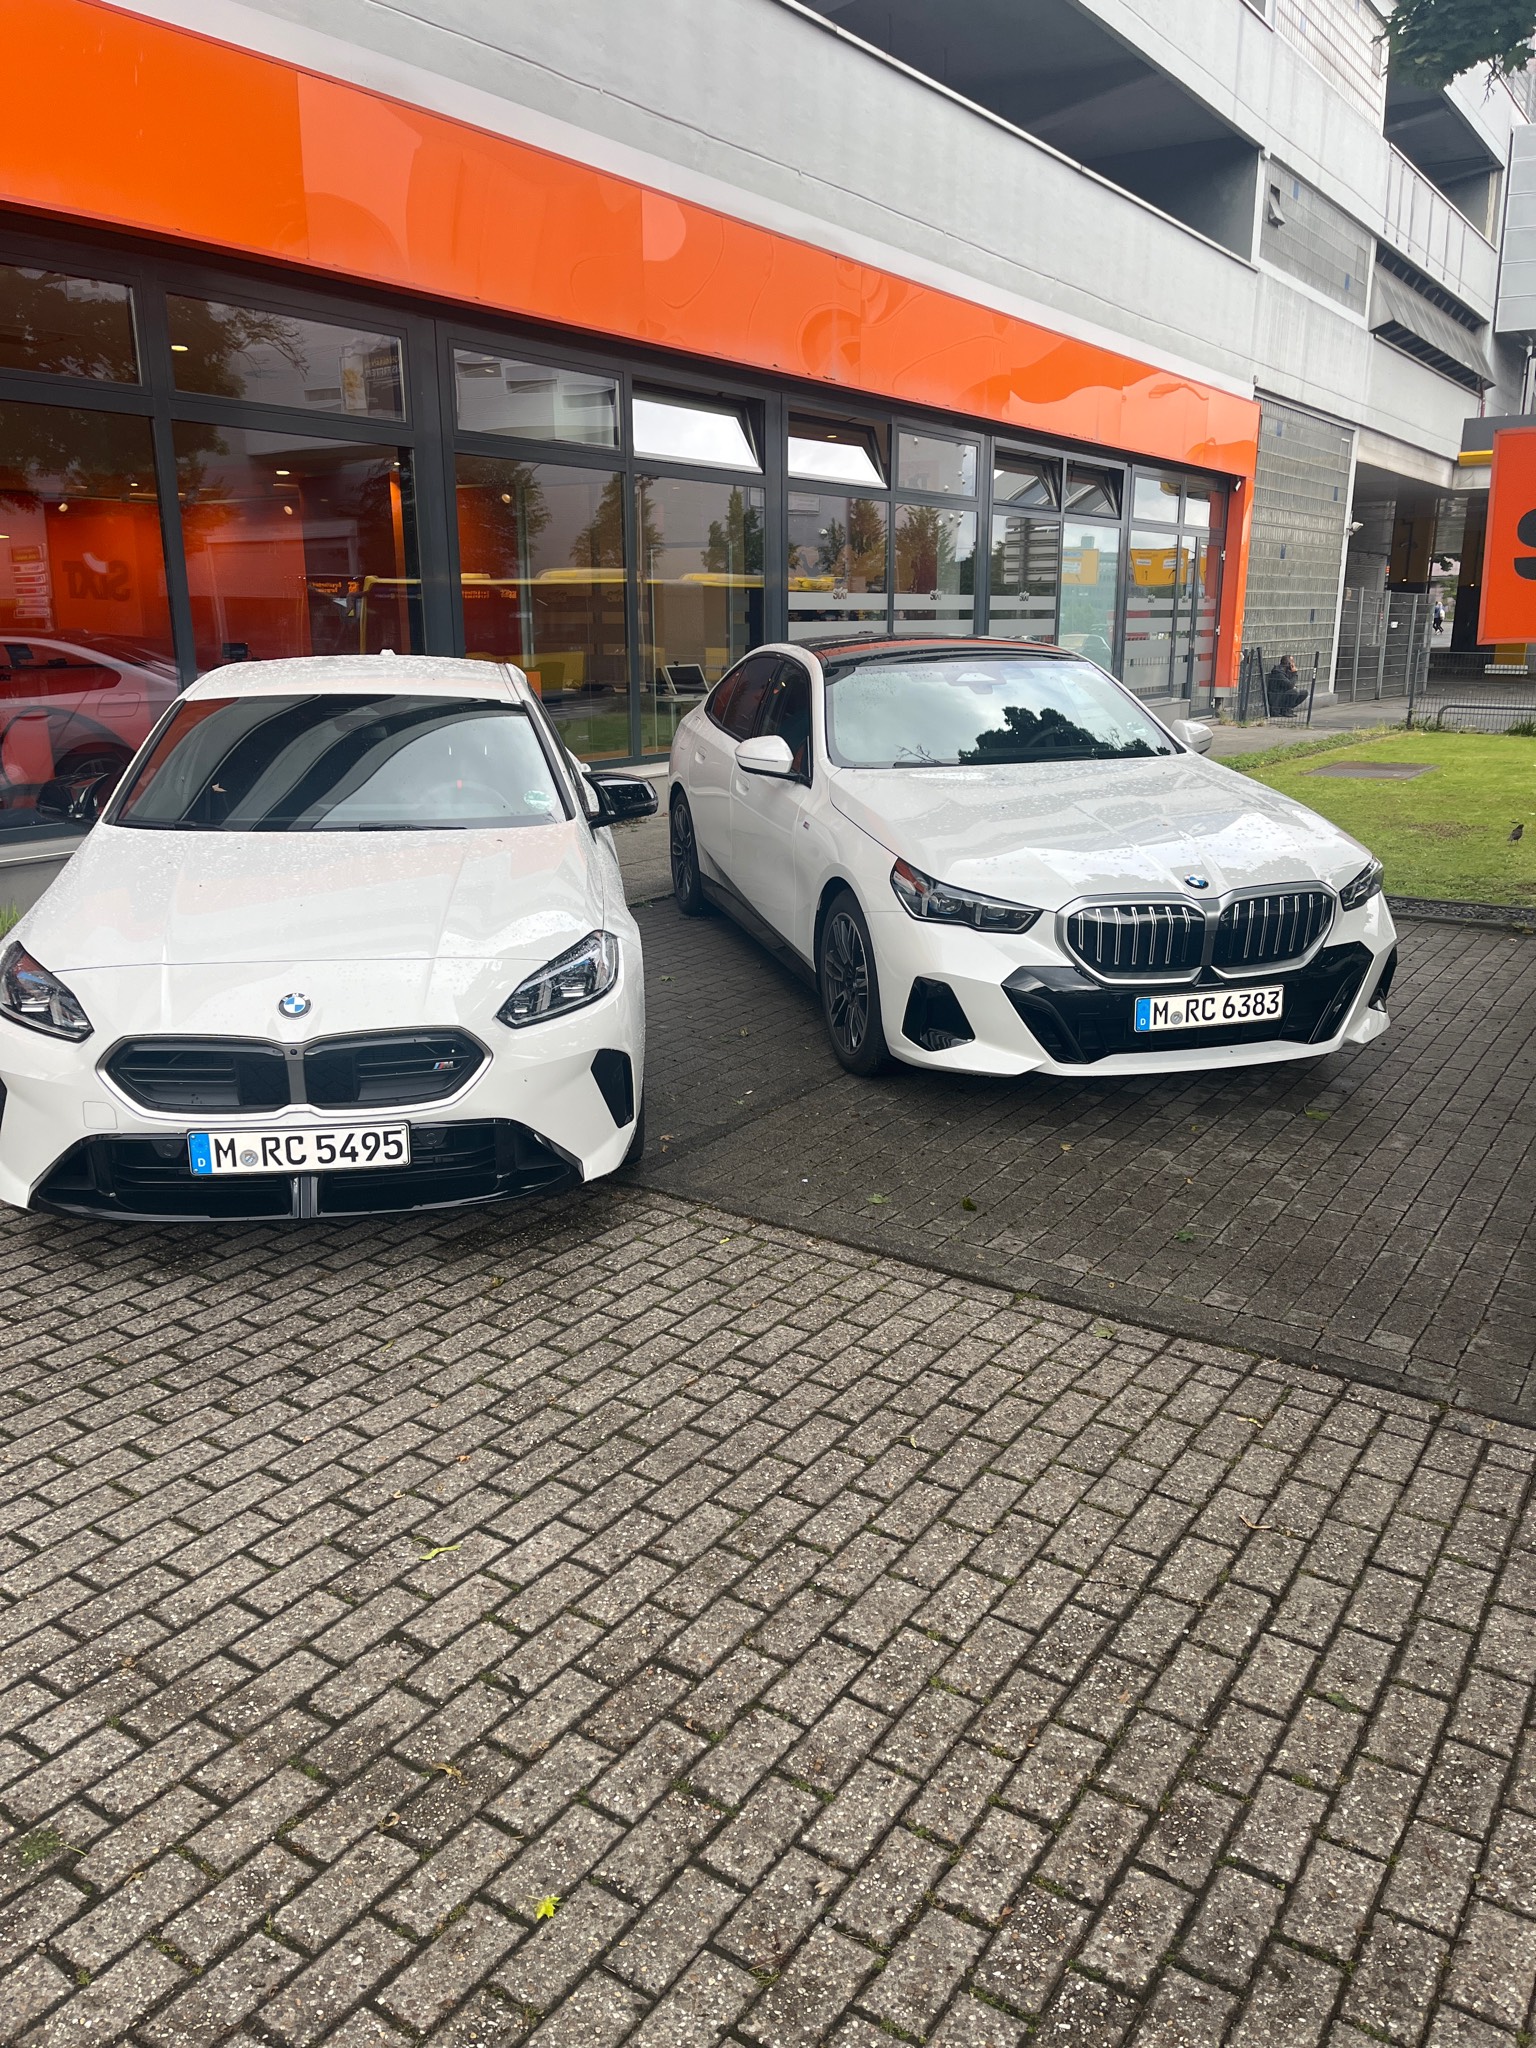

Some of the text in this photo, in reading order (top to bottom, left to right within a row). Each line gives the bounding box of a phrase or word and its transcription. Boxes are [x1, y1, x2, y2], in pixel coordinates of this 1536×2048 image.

[1185, 997, 1216, 1023] RC
[1222, 991, 1280, 1019] 6383
[197, 1158, 206, 1167] D
[214, 1130, 403, 1168] M RC 5495
